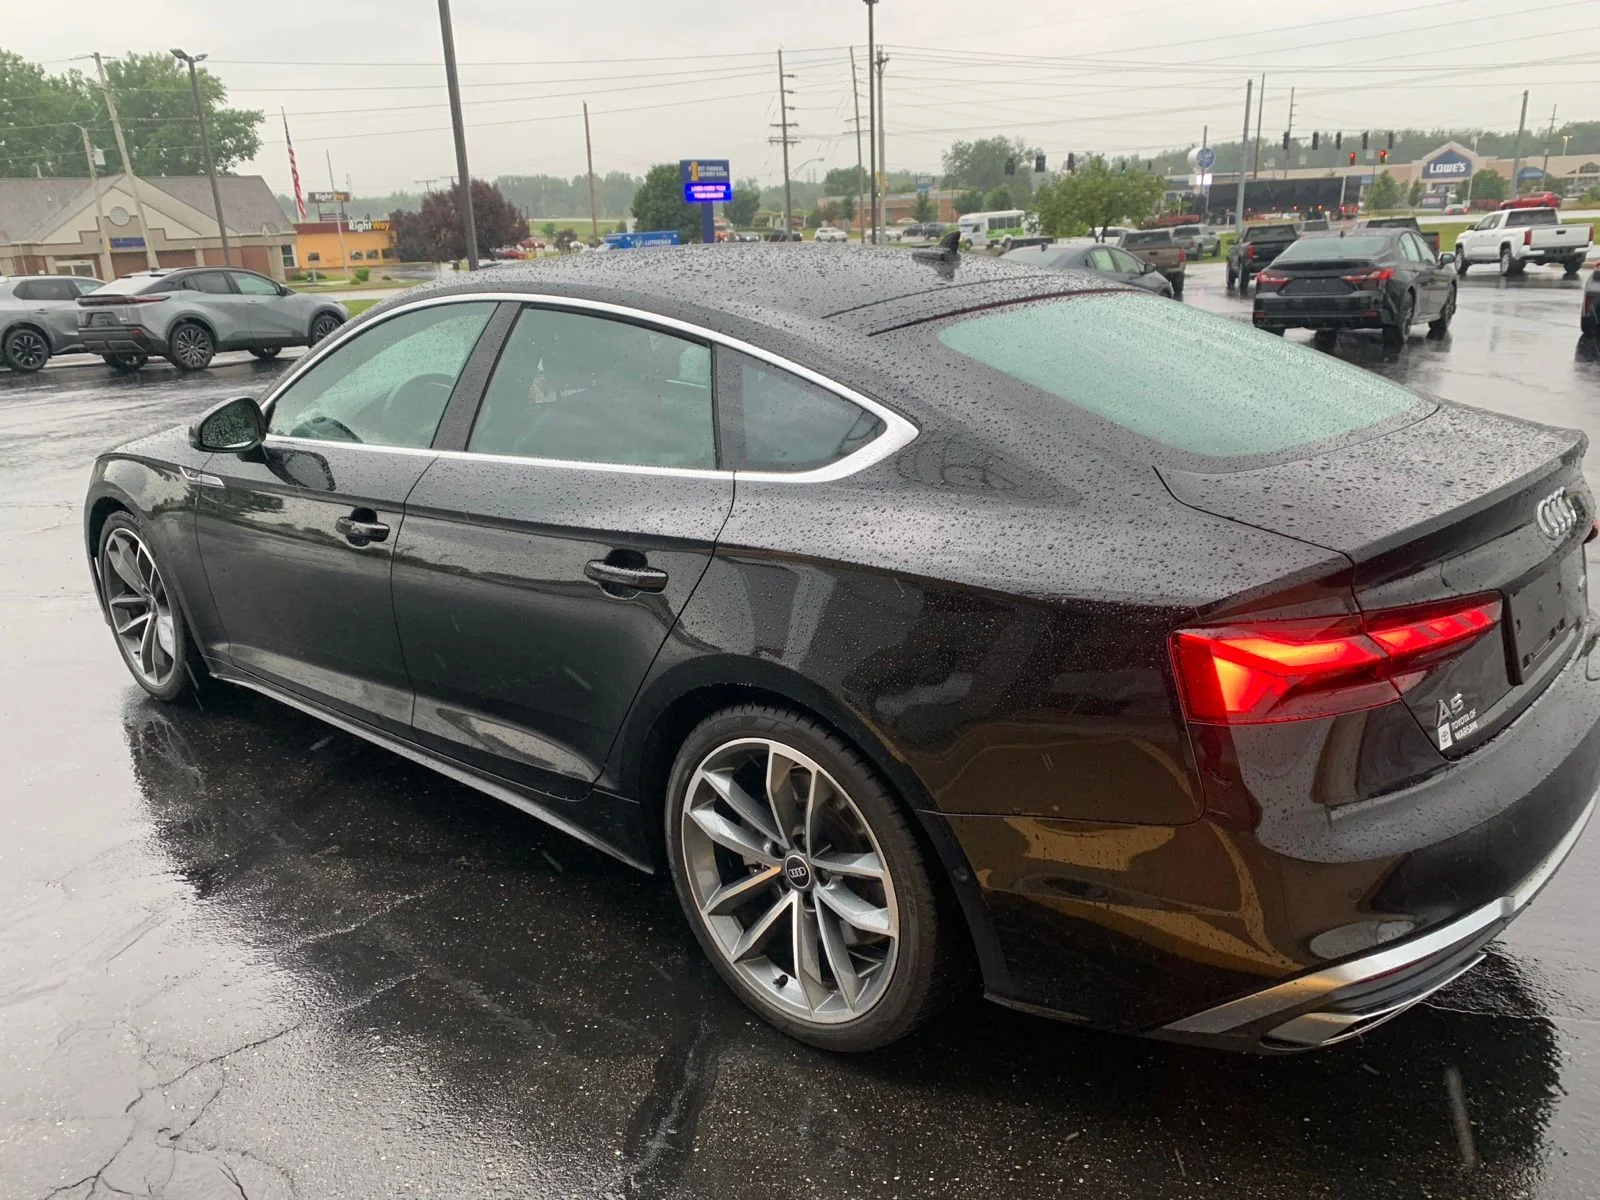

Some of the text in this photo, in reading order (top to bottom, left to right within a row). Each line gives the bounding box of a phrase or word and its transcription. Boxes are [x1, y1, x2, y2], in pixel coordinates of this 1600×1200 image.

[1430, 162, 1466, 173] LOWE'S
[314, 192, 345, 202] Rightay
[349, 219, 390, 232] RightWay
[1434, 693, 1465, 728] A5
[1451, 708, 1477, 730] TOYOTA OF
